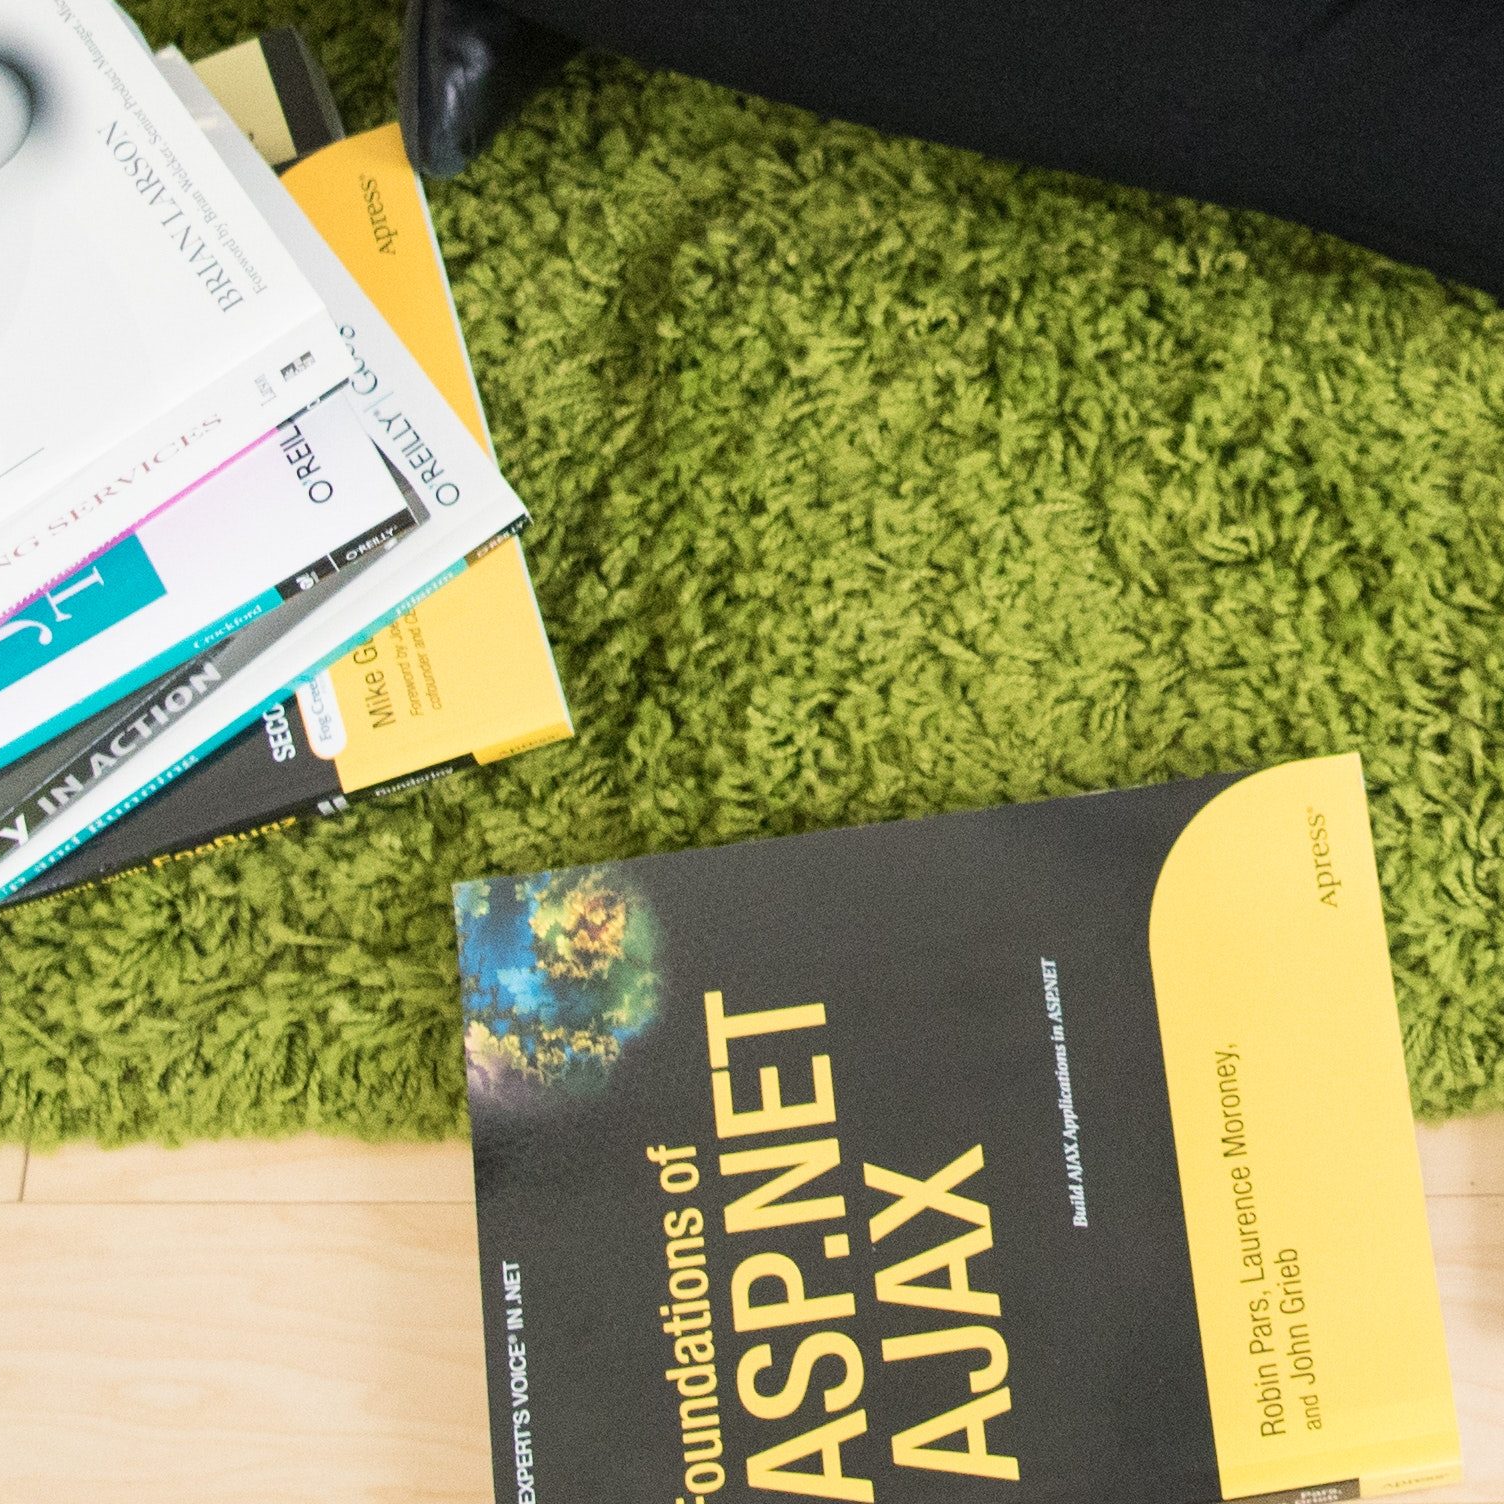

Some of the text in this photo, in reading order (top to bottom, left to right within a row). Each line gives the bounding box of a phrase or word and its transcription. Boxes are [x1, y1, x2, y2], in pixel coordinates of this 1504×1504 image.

[71, 18, 109, 71] Manager,
[102, 66, 138, 111] Product
[131, 107, 163, 146] Senior
[158, 141, 194, 194] Welcker,
[104, 119, 244, 313] BRIAN LARSON
[190, 188, 218, 225] Brian
[212, 221, 229, 241] by
[359, 177, 399, 255] Apress
[220, 236, 268, 295] Foreword
[46, 416, 222, 531] SERVICES
[377, 411, 461, 507] O'REILLY
[192, 603, 267, 657] Crockford
[363, 669, 396, 730] Mike
[36, 767, 84, 825] IN
[86, 660, 225, 792] ACTION
[1306, 812, 1342, 908] Apress
[1039, 956, 1089, 1228] Build AJAX Applications in ASP.NET
[702, 991, 876, 1502] ASP.NET
[1213, 1043, 1287, 1438] Robin Pars, Laurence Moroney,
[500, 1259, 522, 1305] .NET
[863, 1145, 1019, 1480] AJAX
[504, 1306, 524, 1331] IN
[645, 1143, 725, 1504] oundations of
[1272, 1247, 1323, 1431] and John Grieb
[506, 1341, 529, 1408] VOICE
